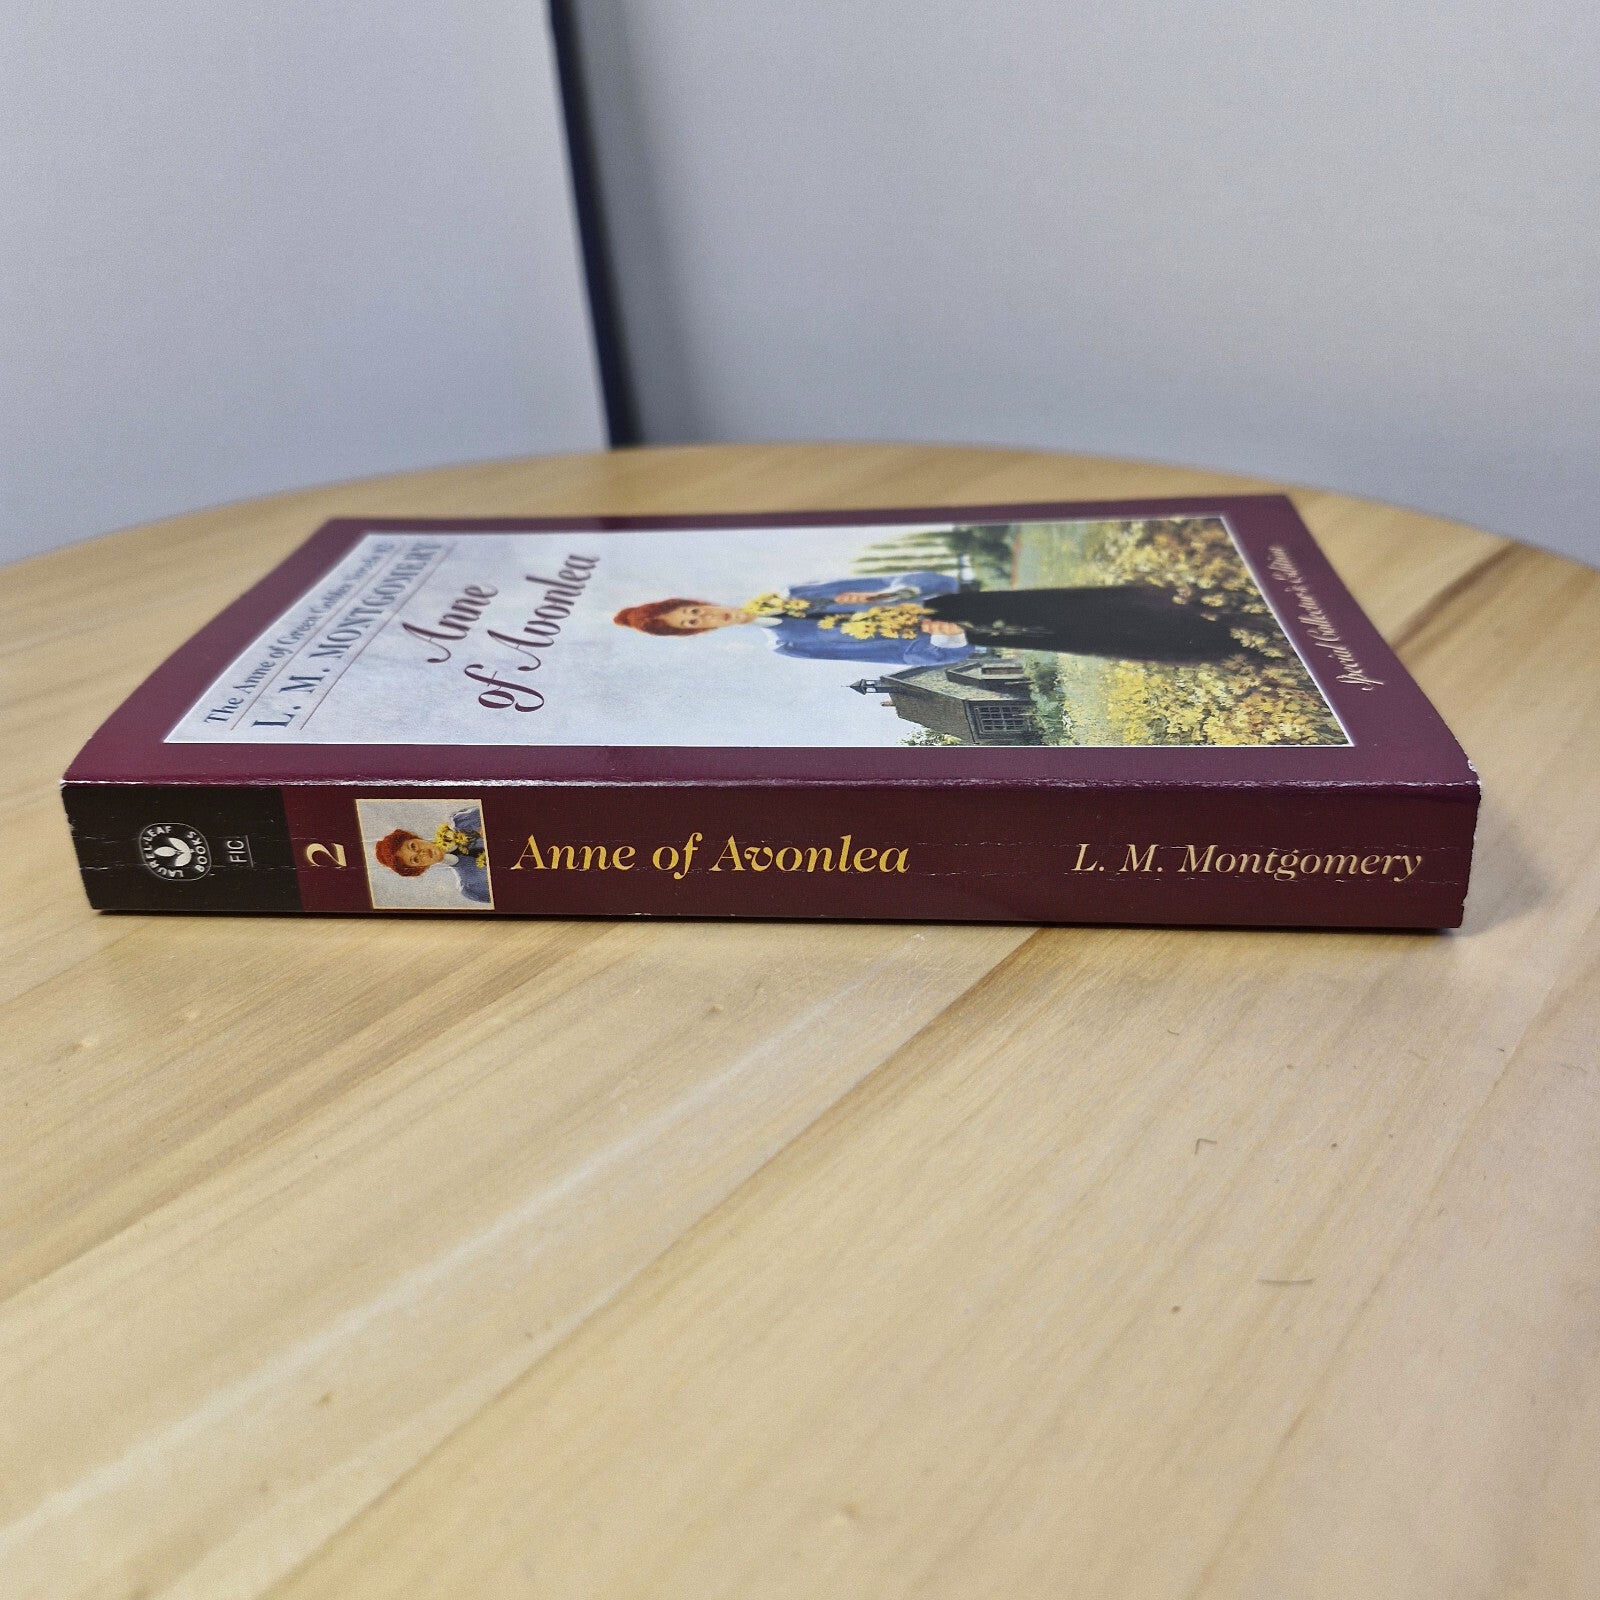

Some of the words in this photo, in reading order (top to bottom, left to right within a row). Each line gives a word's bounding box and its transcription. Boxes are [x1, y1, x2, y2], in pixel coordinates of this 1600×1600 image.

[277, 616, 323, 645] Green
[402, 584, 499, 664] Anne
[487, 553, 601, 672] Avonlea
[251, 706, 302, 727] L.
[279, 668, 331, 694] M.
[310, 541, 443, 660] MONTGOMERY
[268, 646, 293, 659] of
[233, 661, 276, 694] Anne
[1315, 642, 1385, 691] Special
[464, 663, 545, 713] of
[203, 698, 245, 723] The
[186, 831, 208, 873] BOOKS
[226, 840, 248, 863] FIC
[306, 842, 347, 870] 2
[510, 834, 636, 872] Anne
[652, 832, 703, 880] of
[709, 834, 911, 874] Avonlea
[1071, 843, 1105, 873] L.
[1121, 844, 1163, 873] M.
[1178, 844, 1423, 882] Montgomery
